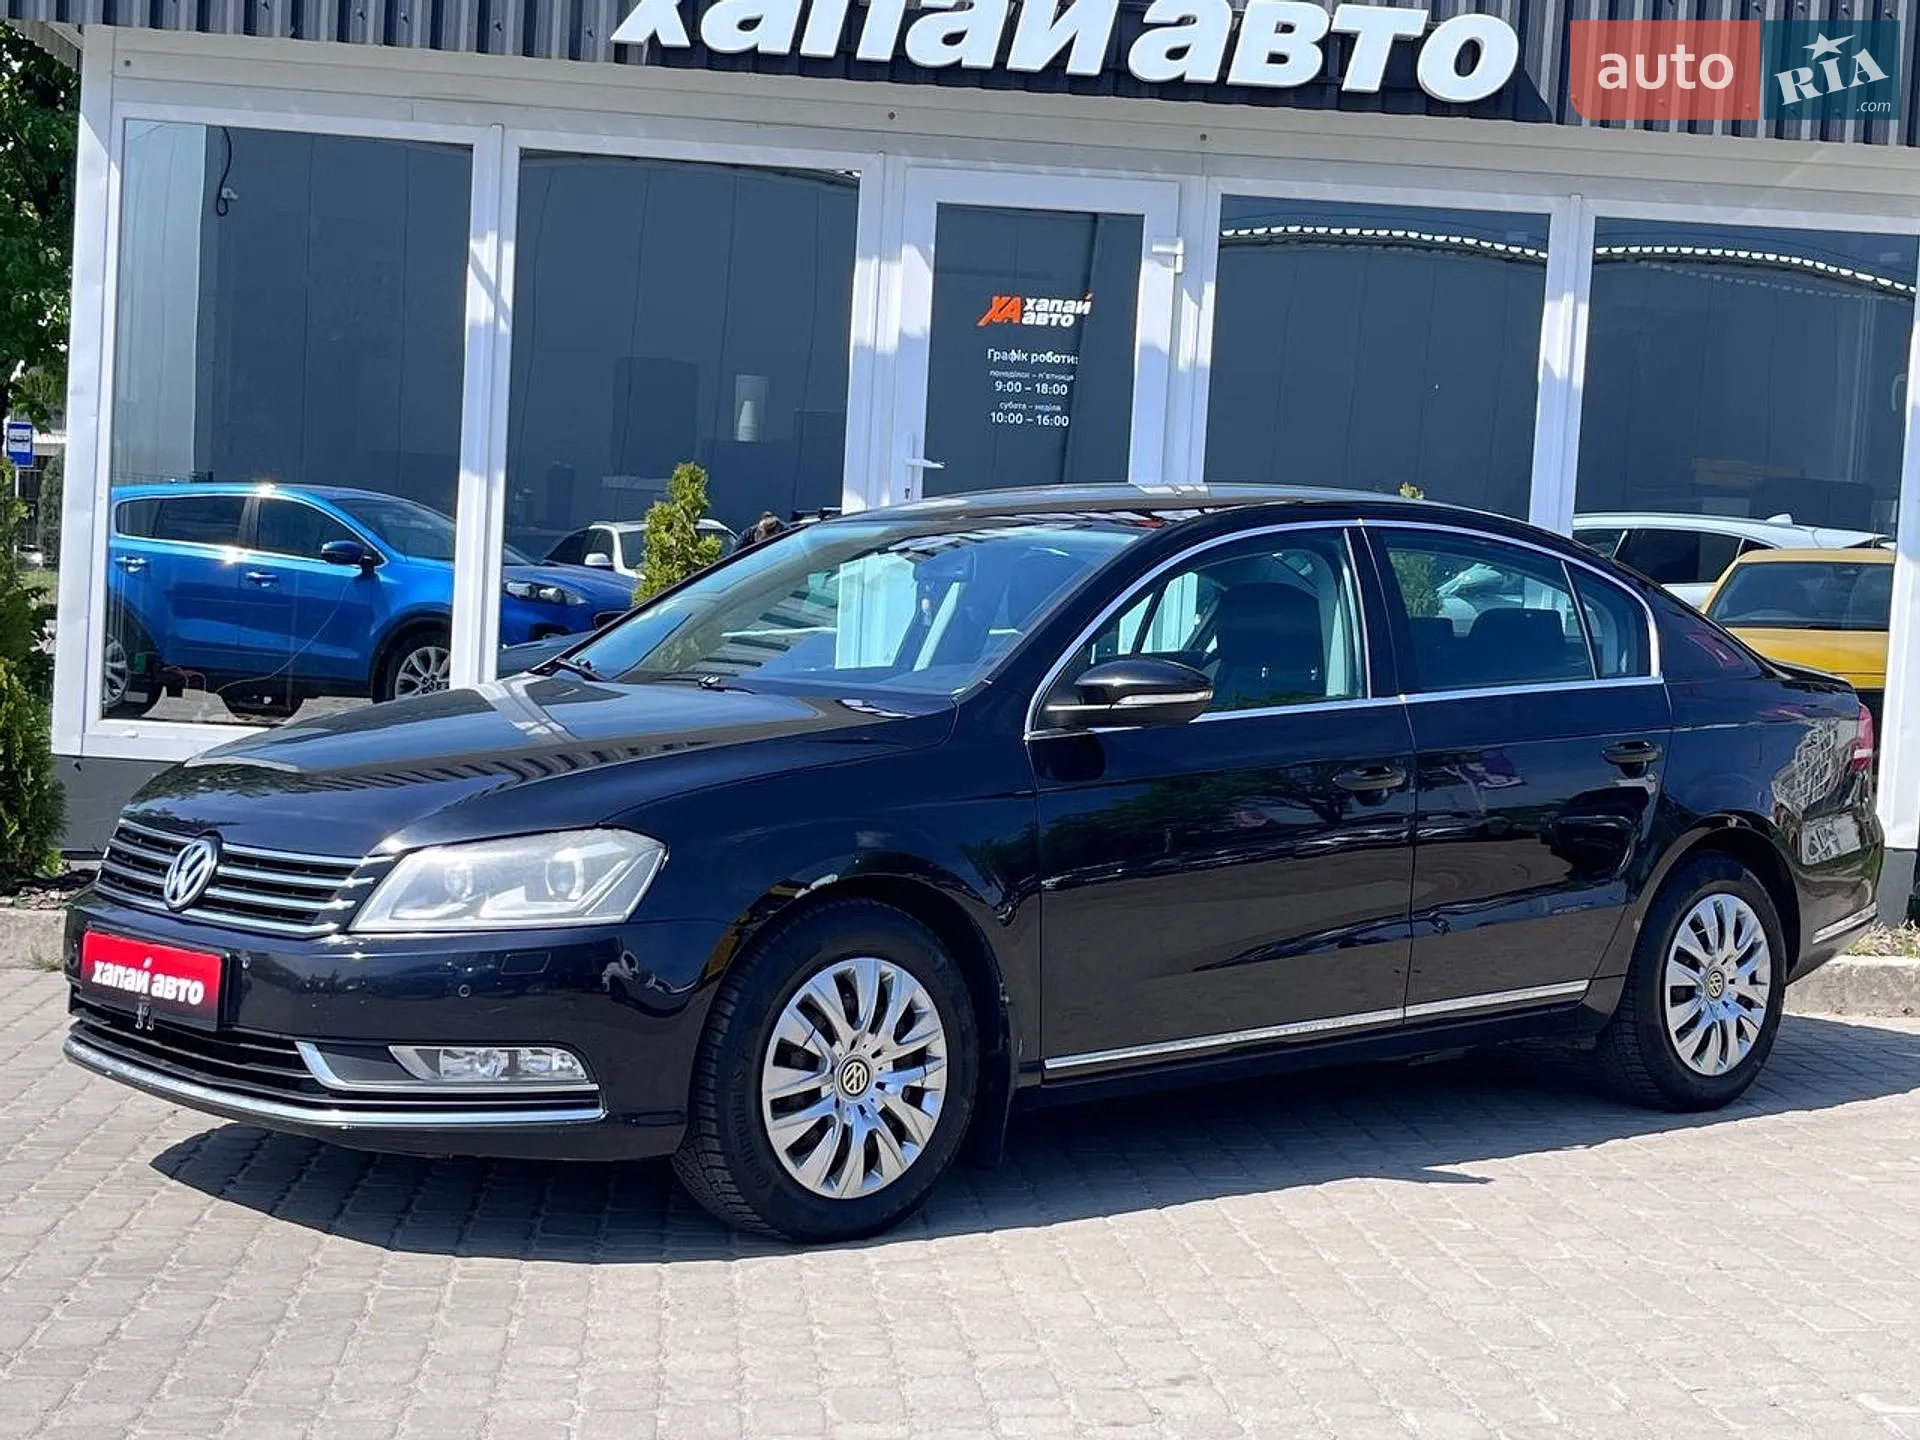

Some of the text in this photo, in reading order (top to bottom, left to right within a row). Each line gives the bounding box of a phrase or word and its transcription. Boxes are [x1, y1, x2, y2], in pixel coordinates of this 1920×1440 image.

[1127, 0, 1519, 103] авто
[1023, 292, 1093, 315] хапай
[1021, 311, 1075, 327] авто
[987, 348, 1028, 363] Графік
[994, 380, 1022, 393] 9:00
[1035, 382, 1068, 396] 18:00
[990, 411, 1023, 424] 10:00
[1037, 414, 1069, 427] 16:00
[91, 956, 205, 1006] хапай авто
